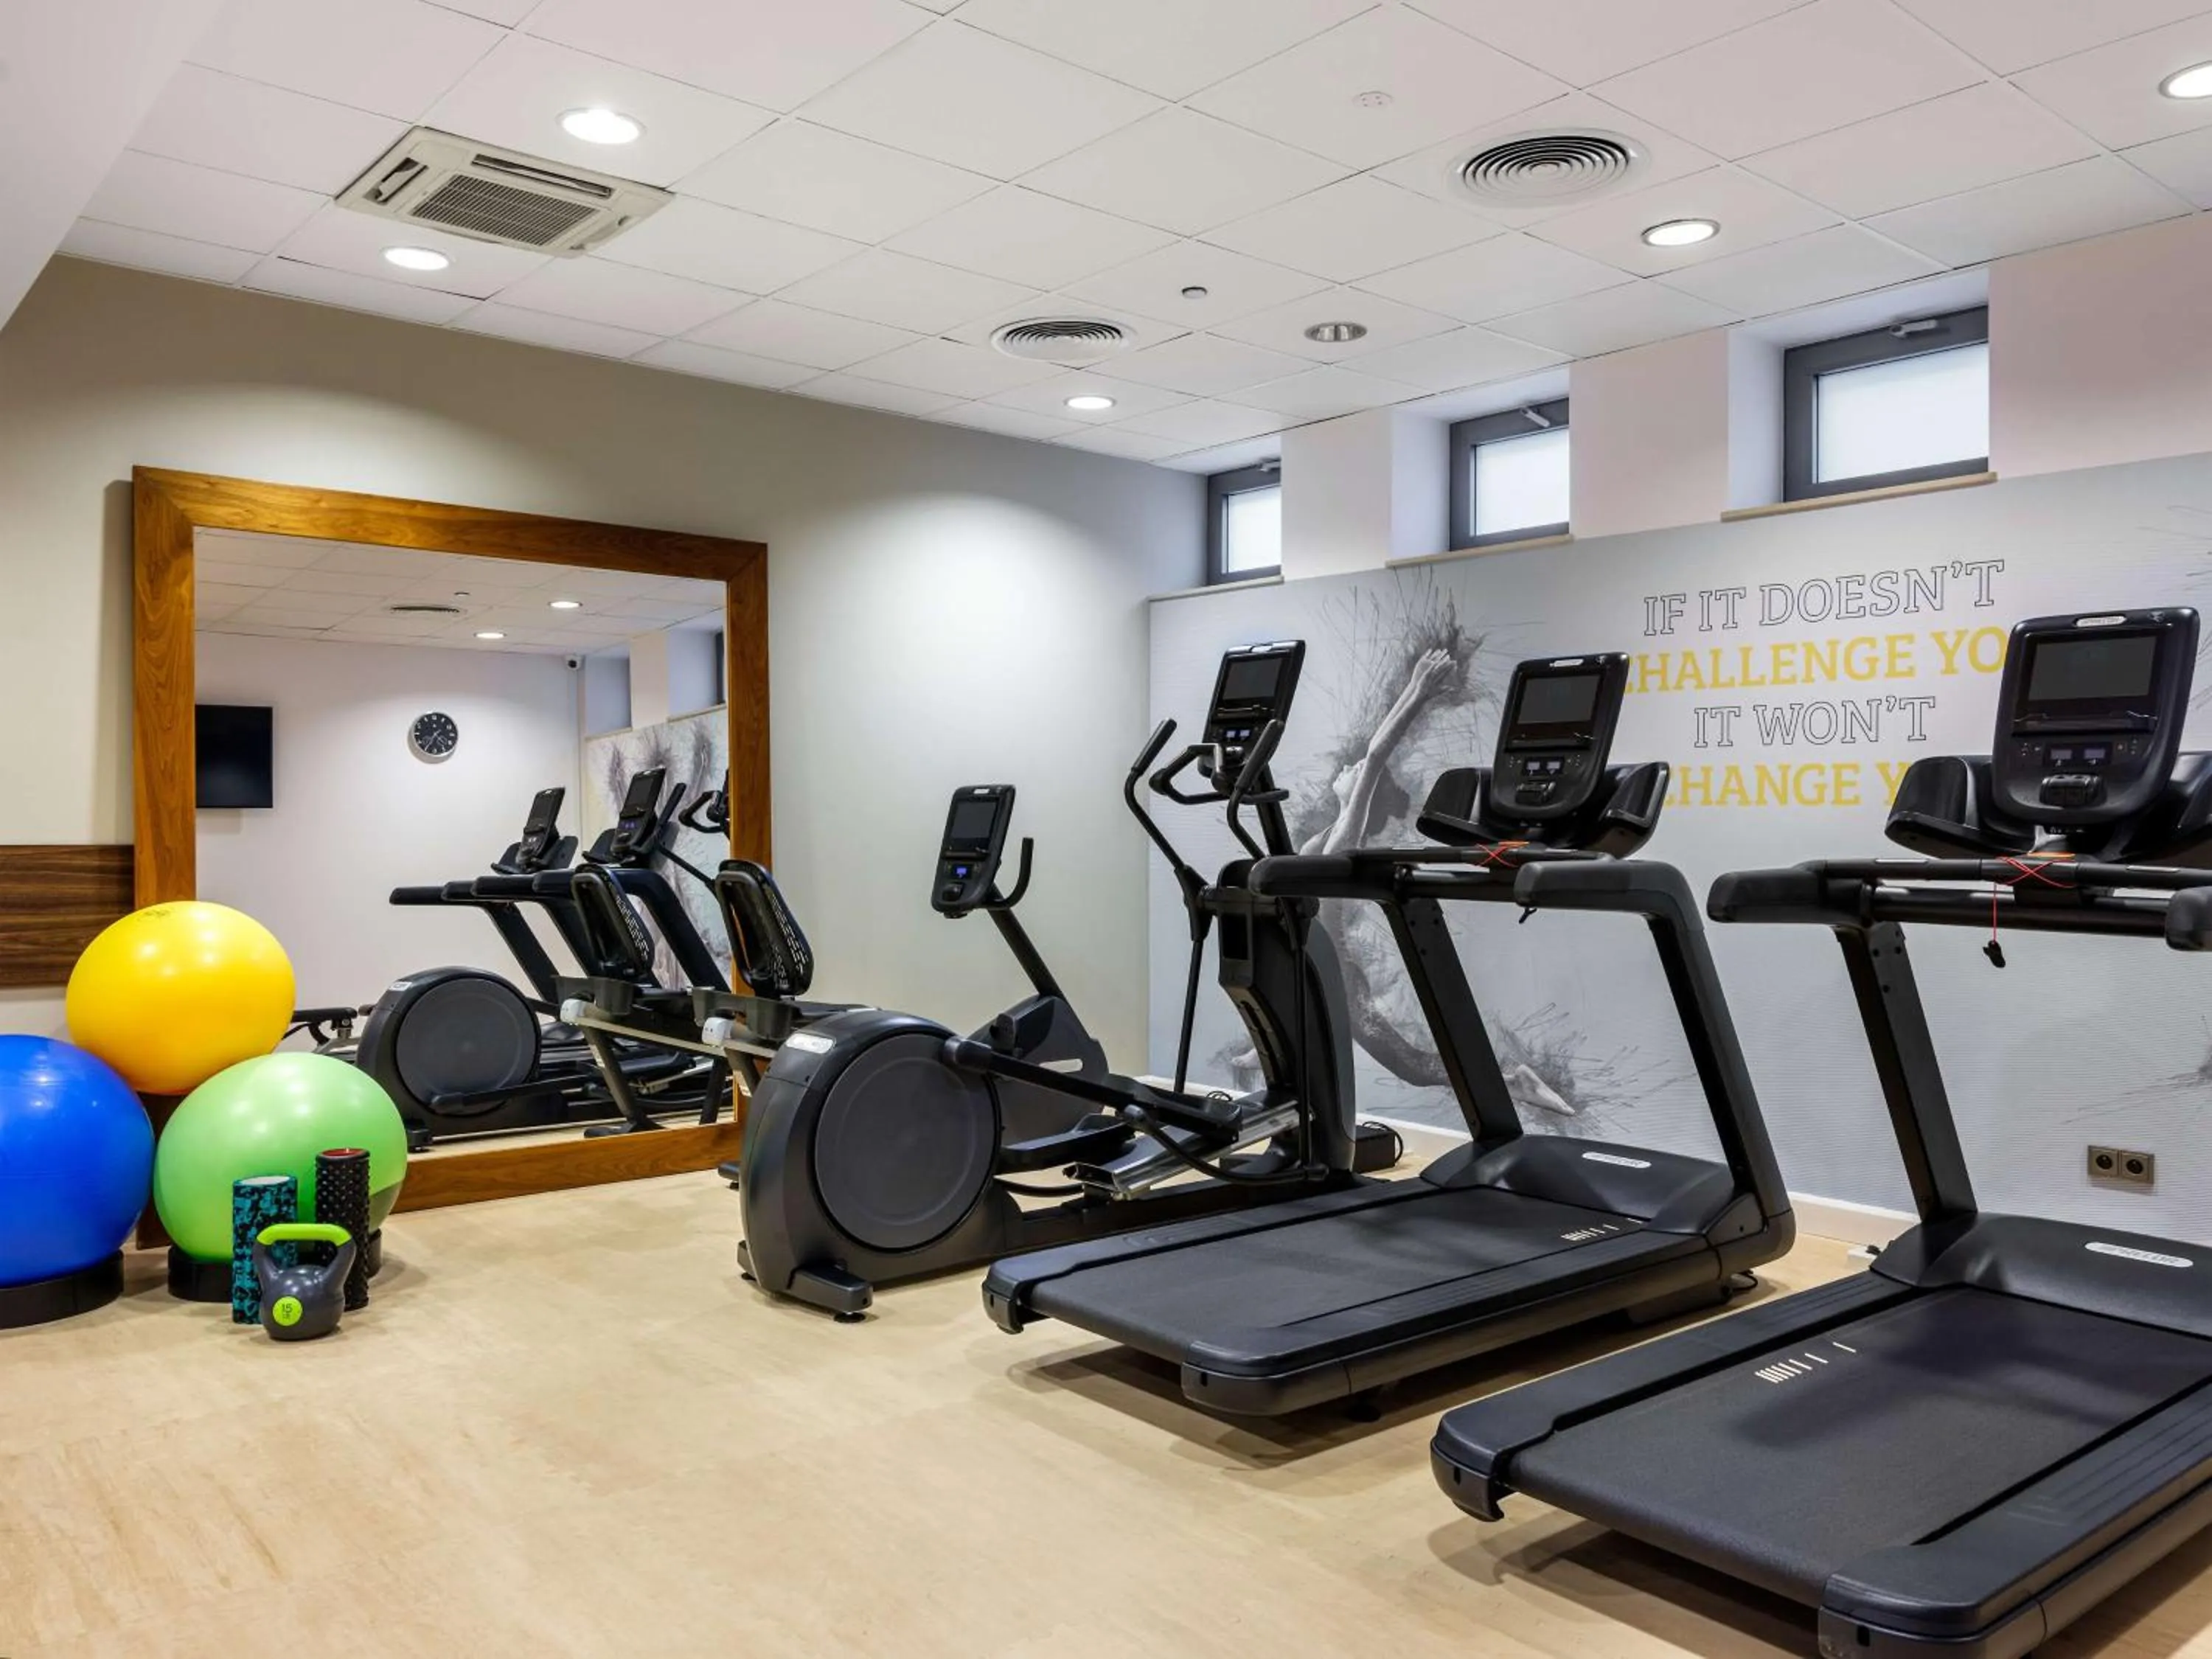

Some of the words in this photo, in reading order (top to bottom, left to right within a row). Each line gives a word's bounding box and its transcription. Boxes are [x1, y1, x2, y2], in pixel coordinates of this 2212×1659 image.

[1644, 592, 1687, 636] IF
[1698, 587, 1747, 632] IT
[1759, 559, 2005, 627] DOESN'T
[1624, 633, 1917, 695] HALLENGE
[1930, 626, 2008, 675] YO
[1693, 706, 1742, 748] IT
[1752, 695, 1936, 746] WON'T
[1663, 762, 1863, 807] HANGE
[282, 1302, 293, 1314] 15
